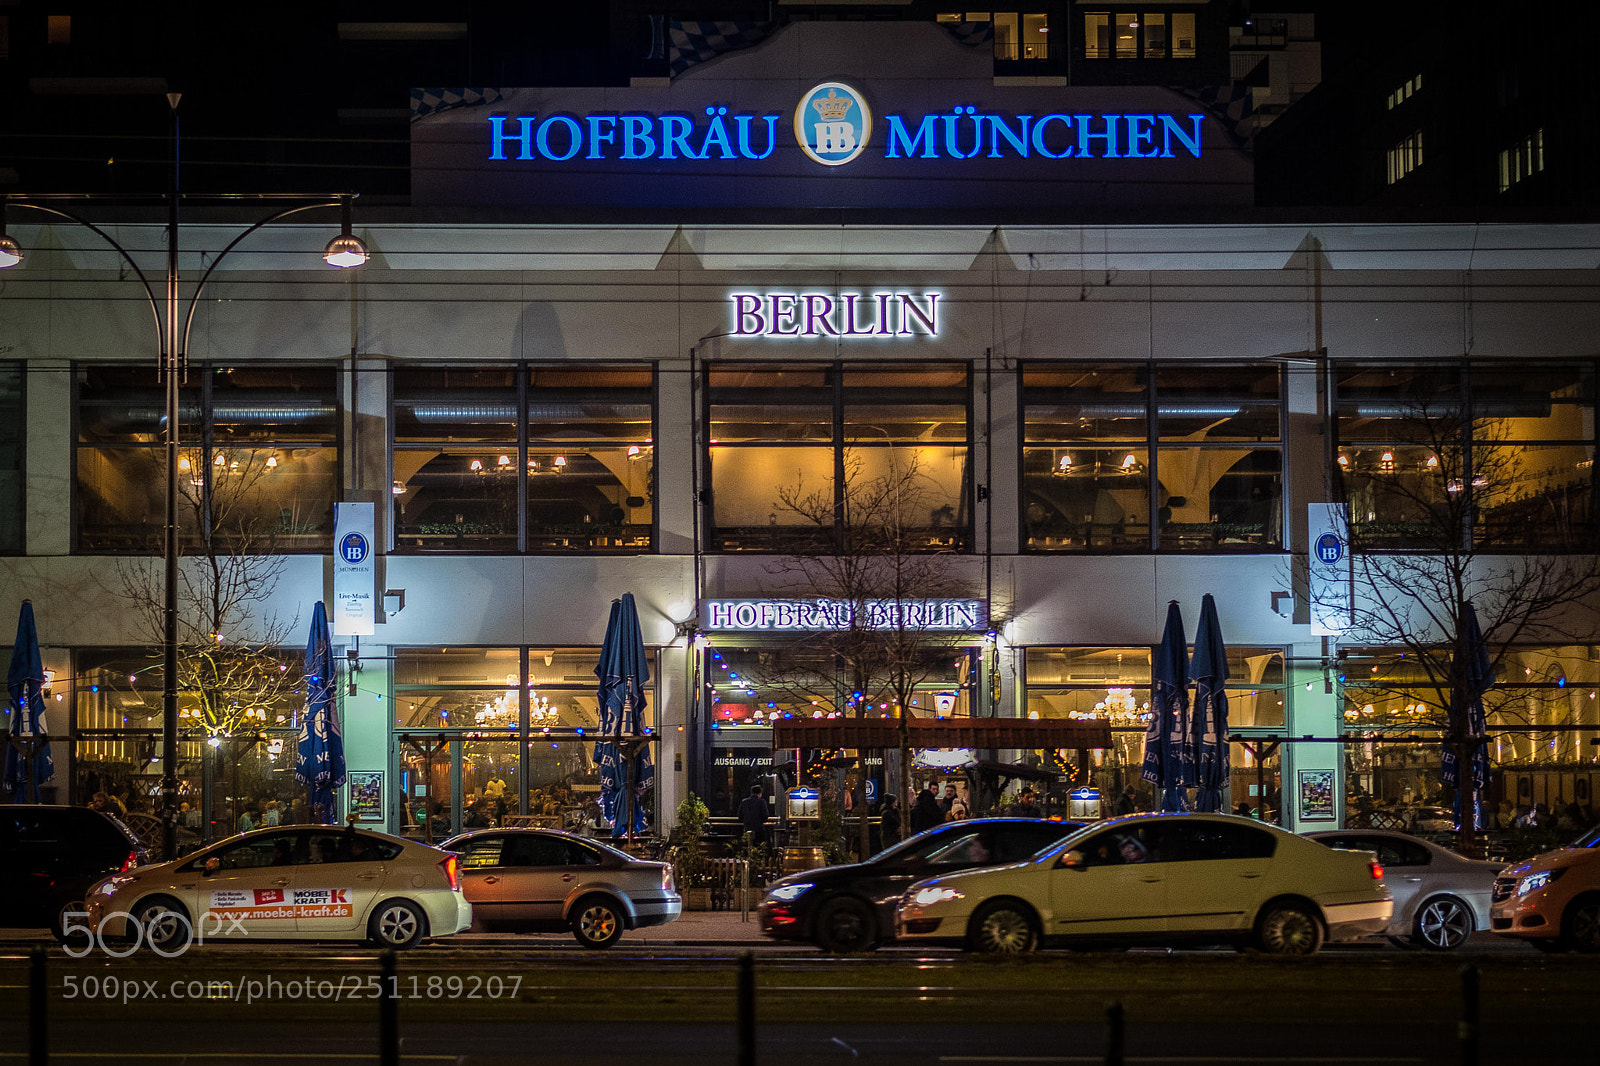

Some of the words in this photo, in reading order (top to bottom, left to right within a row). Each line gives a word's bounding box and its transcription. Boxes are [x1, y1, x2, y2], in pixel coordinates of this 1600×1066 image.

[488, 106, 779, 161] HOFBRÄU
[814, 122, 856, 153] HB
[885, 105, 1205, 160] MÜNCHEN
[727, 290, 943, 340] BERLIN
[347, 547, 362, 560] HB
[1322, 547, 1337, 560] HB
[709, 598, 853, 629] HOFBRÄU
[867, 602, 977, 630] BERLIN
[714, 757, 750, 766] AUSGANG
[756, 757, 773, 766] EXIT
[294, 890, 331, 898] MÖBEL
[215, 906, 349, 920] www.moebel-kraft.de
